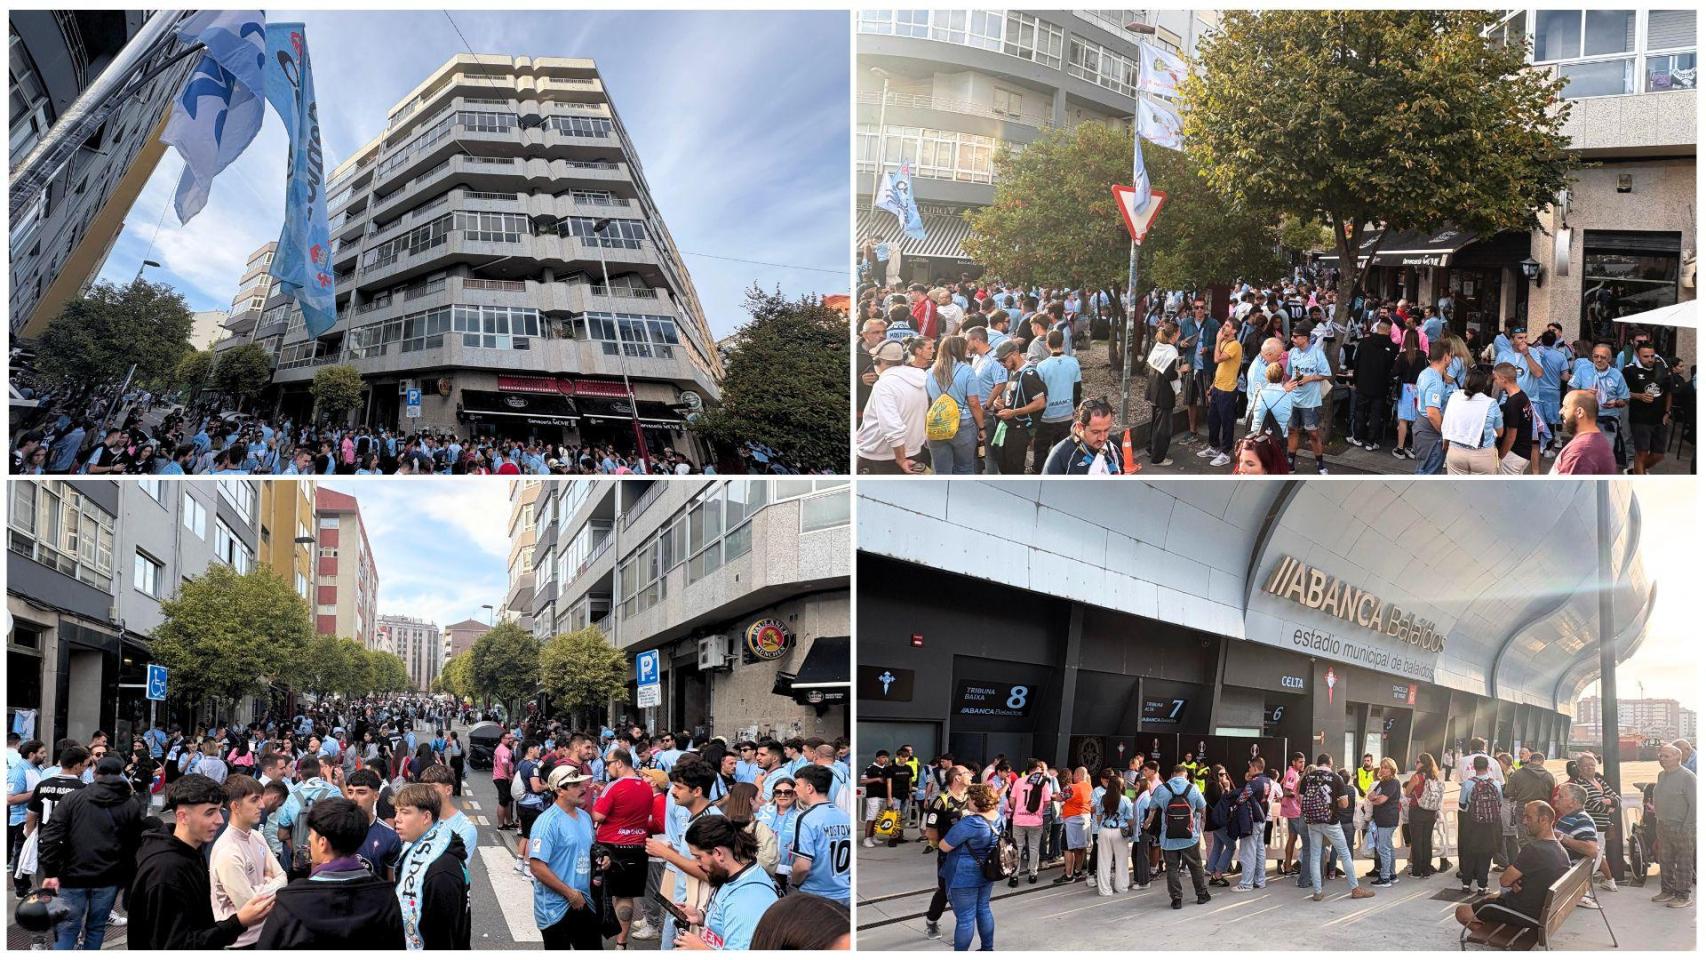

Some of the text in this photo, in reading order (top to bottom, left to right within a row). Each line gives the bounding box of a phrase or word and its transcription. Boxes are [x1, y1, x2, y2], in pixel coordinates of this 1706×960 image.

[1293, 628, 1340, 655] estadio
[1342, 642, 1390, 668] municipal
[1391, 655, 1402, 671] de
[640, 655, 653, 682] P
[966, 687, 996, 696] TRIBUNA
[1281, 675, 1304, 689] CELTA
[964, 693, 985, 701] BAIXA
[1006, 685, 1028, 709] 8
[1169, 699, 1184, 718] 7
[1272, 705, 1284, 721] 6
[829, 839, 850, 877] 10
